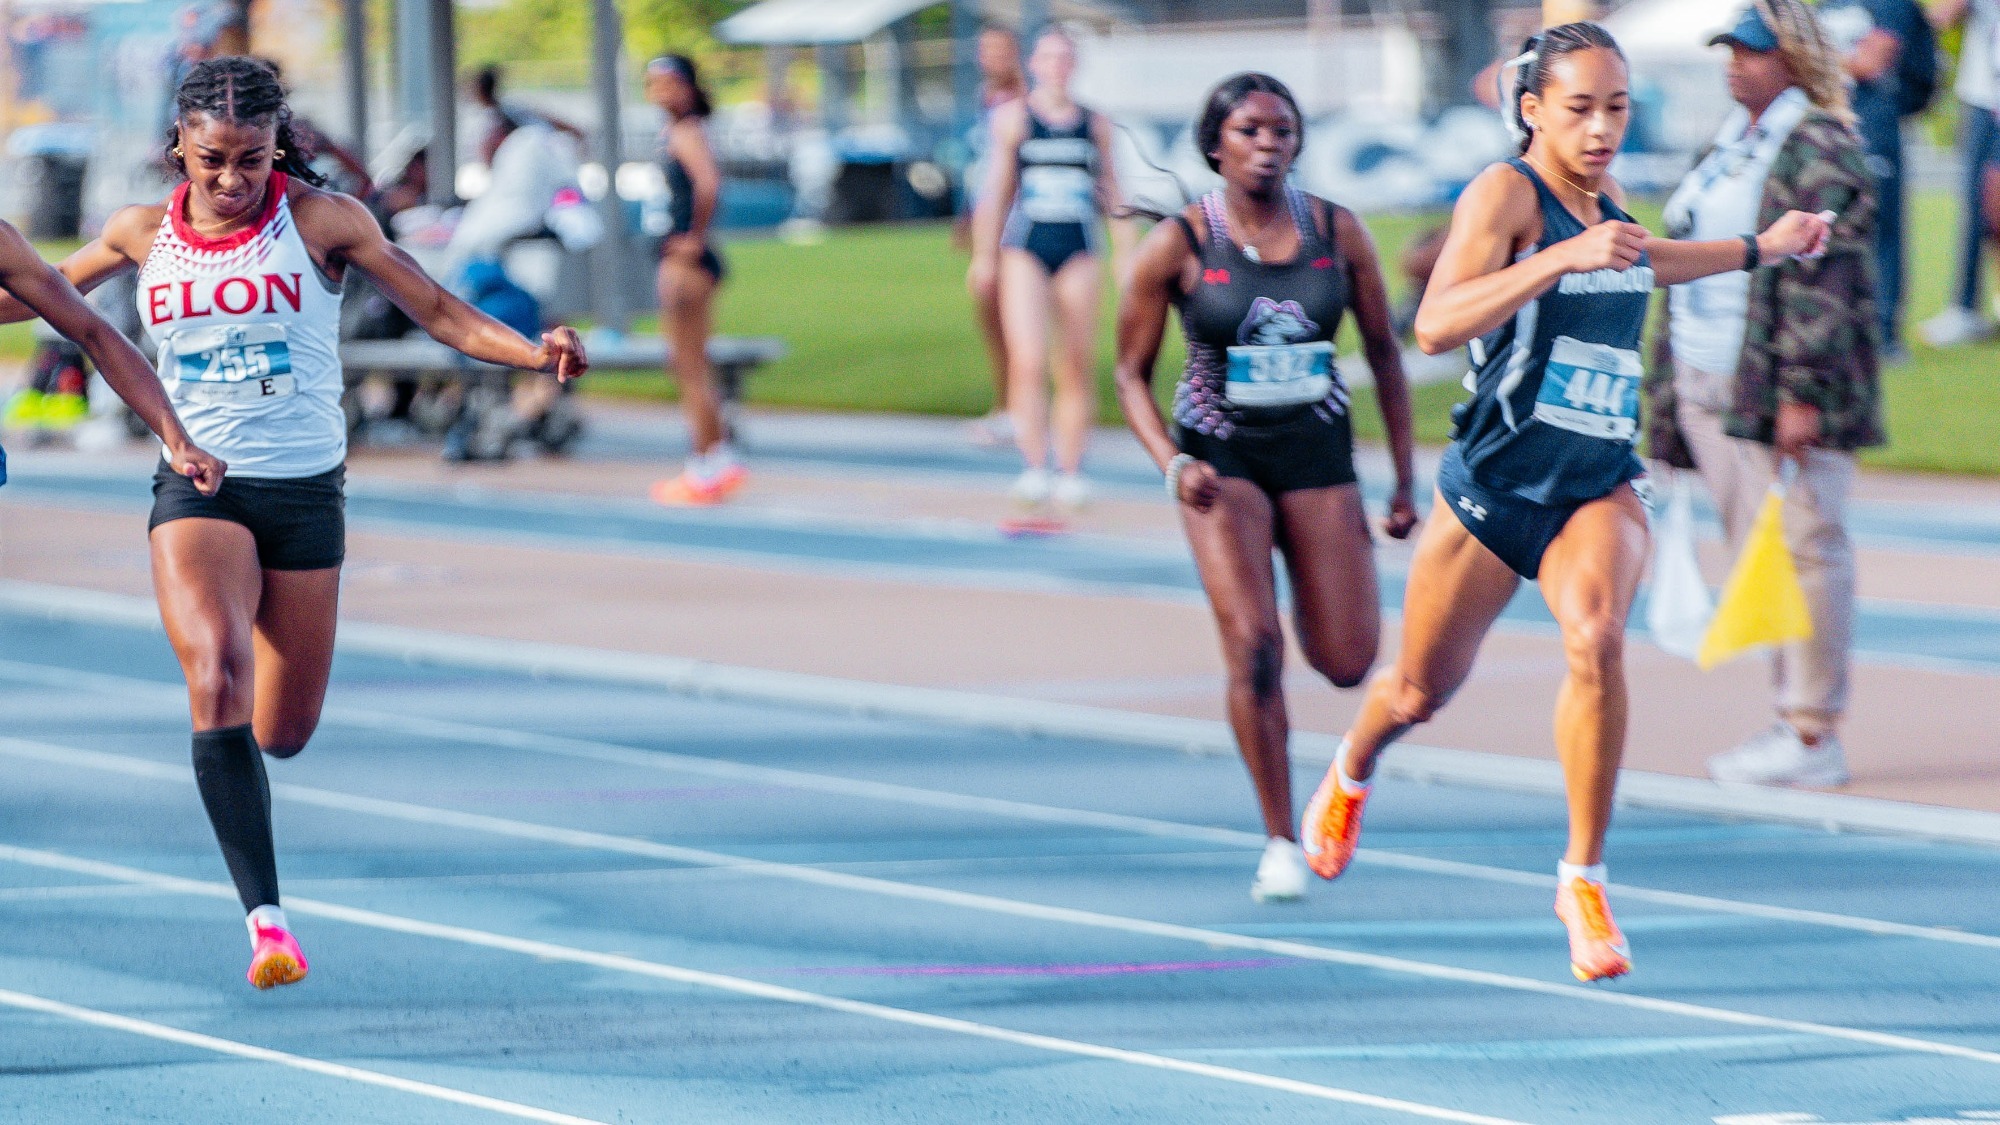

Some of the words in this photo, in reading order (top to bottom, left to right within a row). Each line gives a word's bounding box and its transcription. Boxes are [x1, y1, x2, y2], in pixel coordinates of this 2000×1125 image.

[149, 273, 303, 326] ELON
[200, 345, 271, 382] 255
[260, 379, 276, 396] E
